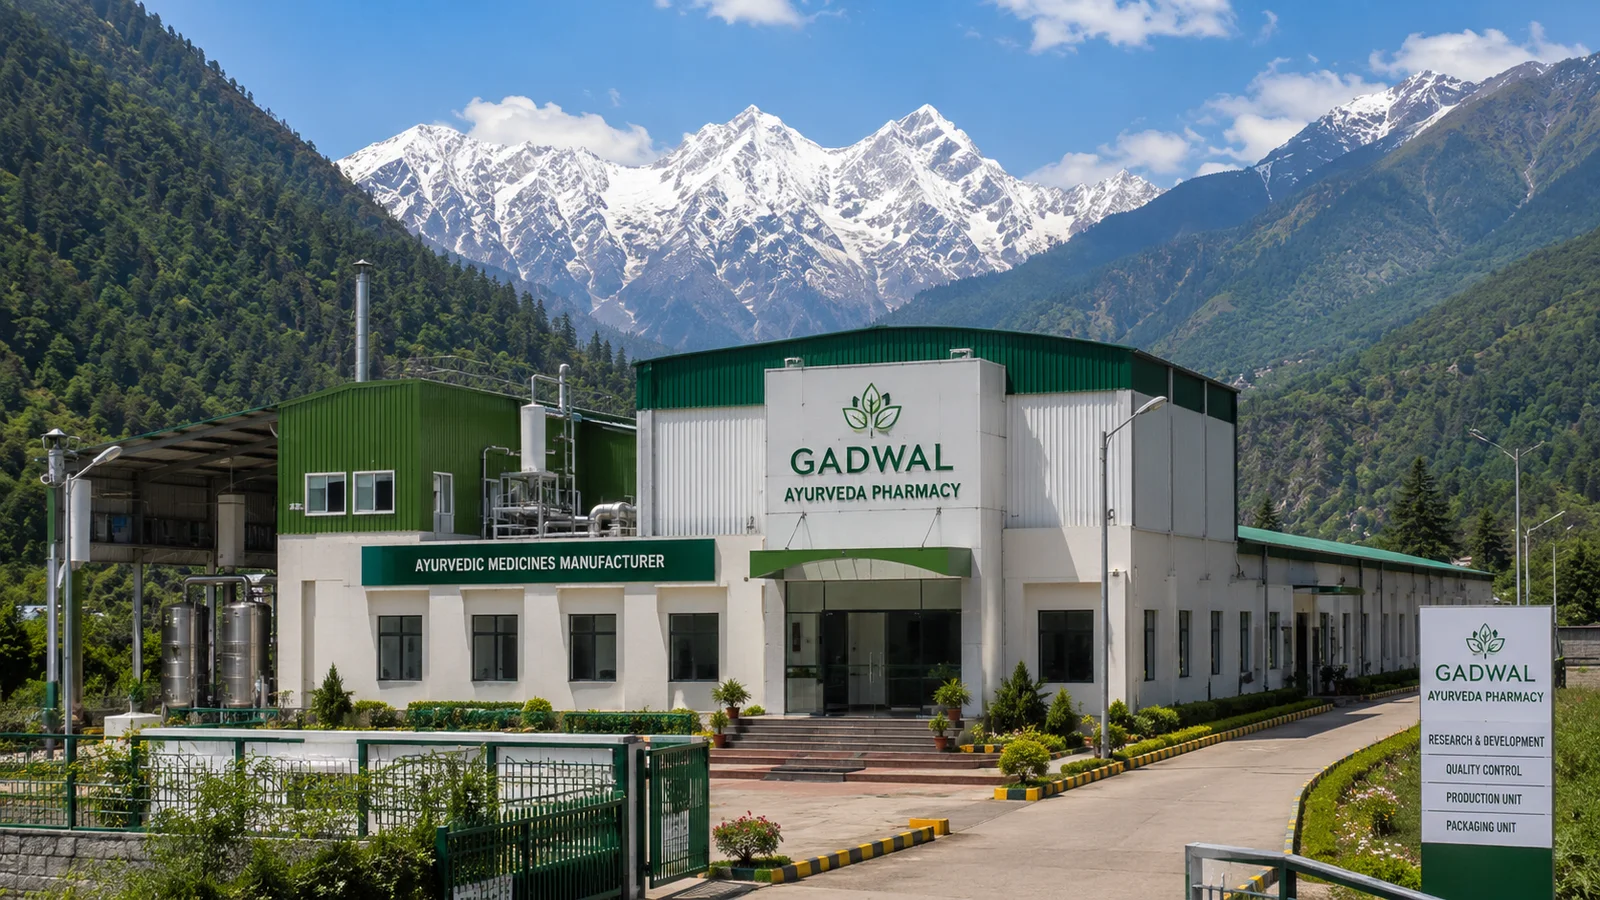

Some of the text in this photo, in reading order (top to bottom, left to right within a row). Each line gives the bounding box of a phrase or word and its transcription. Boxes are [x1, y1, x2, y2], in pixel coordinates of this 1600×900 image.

[790, 443, 954, 475] GADWAL
[784, 482, 961, 502] AYURVEDA PHARMACY
[415, 554, 665, 572] AYURVEDIC MEDICINES MANUFACTURER
[1435, 664, 1536, 682] GADWAL
[1428, 690, 1544, 703] AYURVEDA PHARMACY
[1428, 734, 1545, 748] RESEARCH & DEVELOPMENT
[1446, 763, 1522, 776] QUALITY CONTROL
[1446, 792, 1522, 805] PRODUCTION UNIT
[1446, 820, 1517, 833] PACKAGING UNIT
